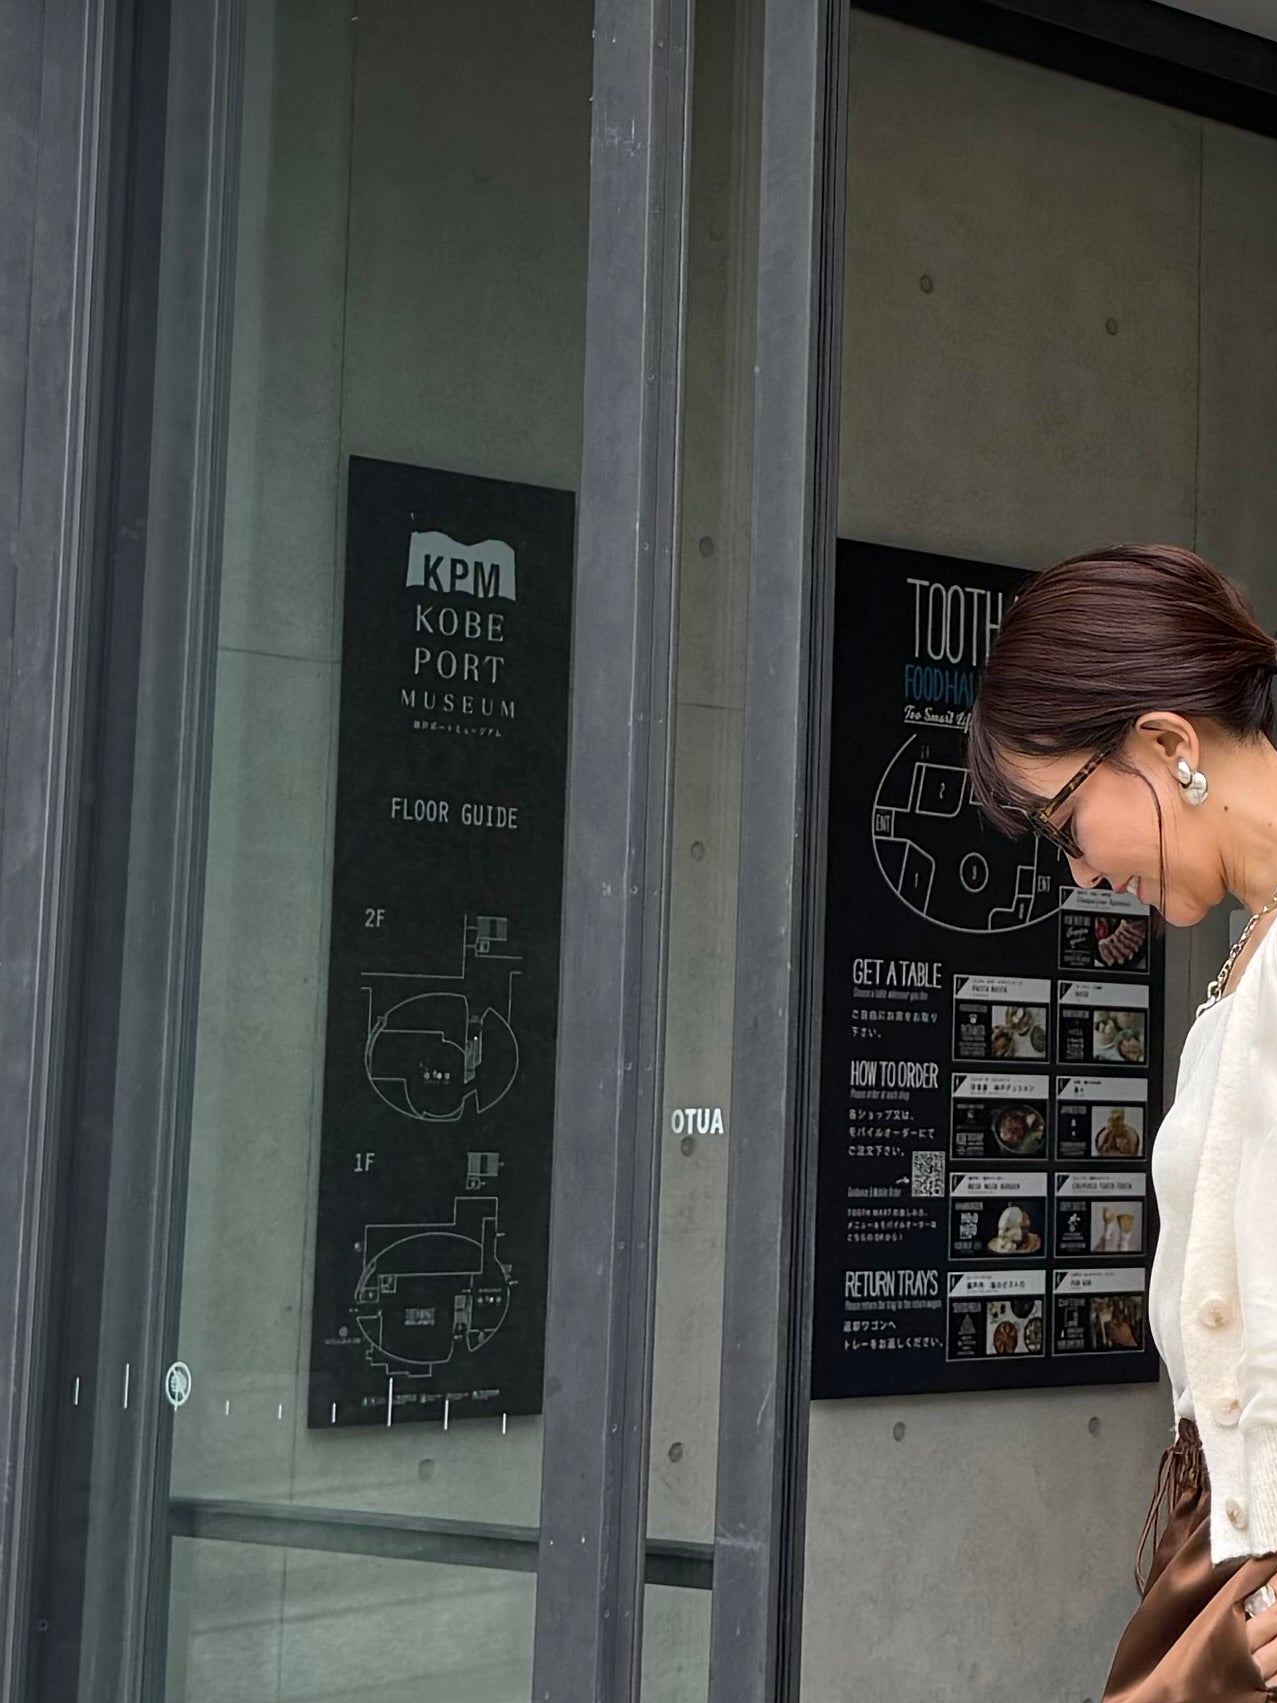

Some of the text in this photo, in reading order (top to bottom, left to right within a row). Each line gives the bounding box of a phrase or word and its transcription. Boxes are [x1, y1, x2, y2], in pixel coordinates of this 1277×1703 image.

[424, 554, 500, 598] KPM
[416, 604, 504, 642] KOBE
[414, 647, 504, 684] PORT
[400, 688, 515, 719] MUSEUM
[904, 705, 922, 720] Too
[391, 797, 518, 829] FLOOR GUIDE
[365, 909, 385, 928] 2F
[852, 958, 884, 985] GET
[886, 960, 897, 986] A
[899, 961, 942, 989] TABLE
[850, 1060, 877, 1087] HOW
[879, 1061, 896, 1088] TO
[898, 1061, 939, 1089] ORDER
[354, 1152, 375, 1172] 1F
[845, 1270, 895, 1297] RETURN
[897, 1269, 939, 1297] TRAYS
